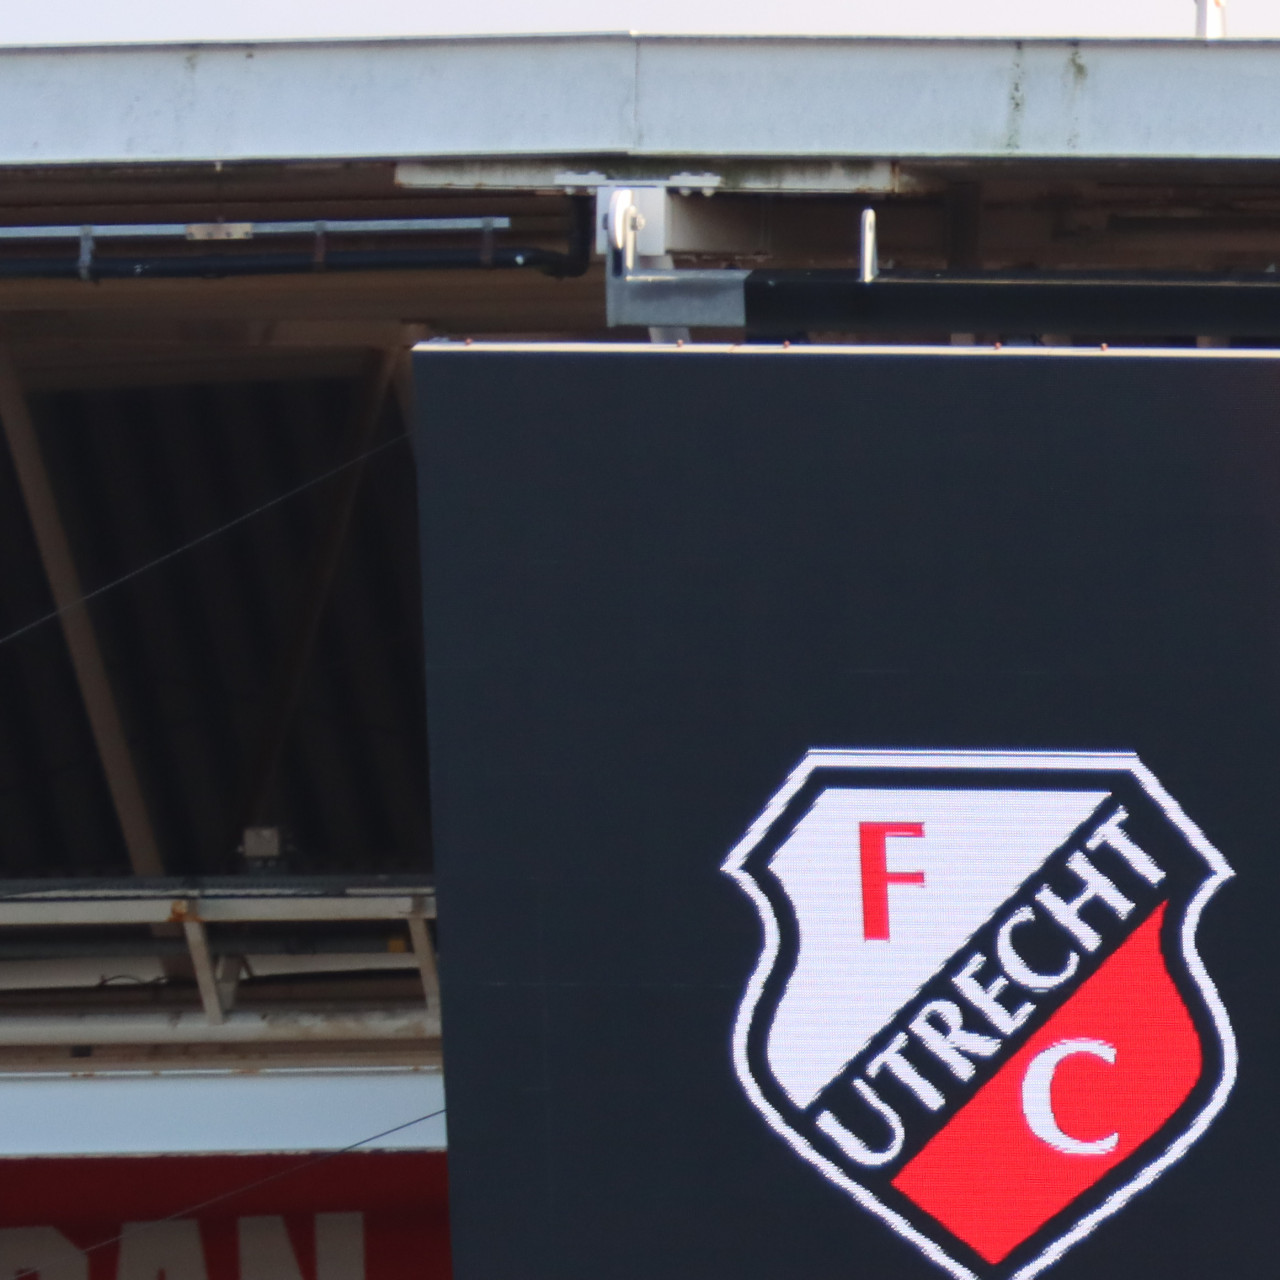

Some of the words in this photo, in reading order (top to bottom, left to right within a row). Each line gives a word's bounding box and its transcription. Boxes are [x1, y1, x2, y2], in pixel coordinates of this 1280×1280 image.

[859, 821, 926, 942] F
[815, 804, 1167, 1166] UTRECHT
[1021, 1036, 1119, 1155] C
